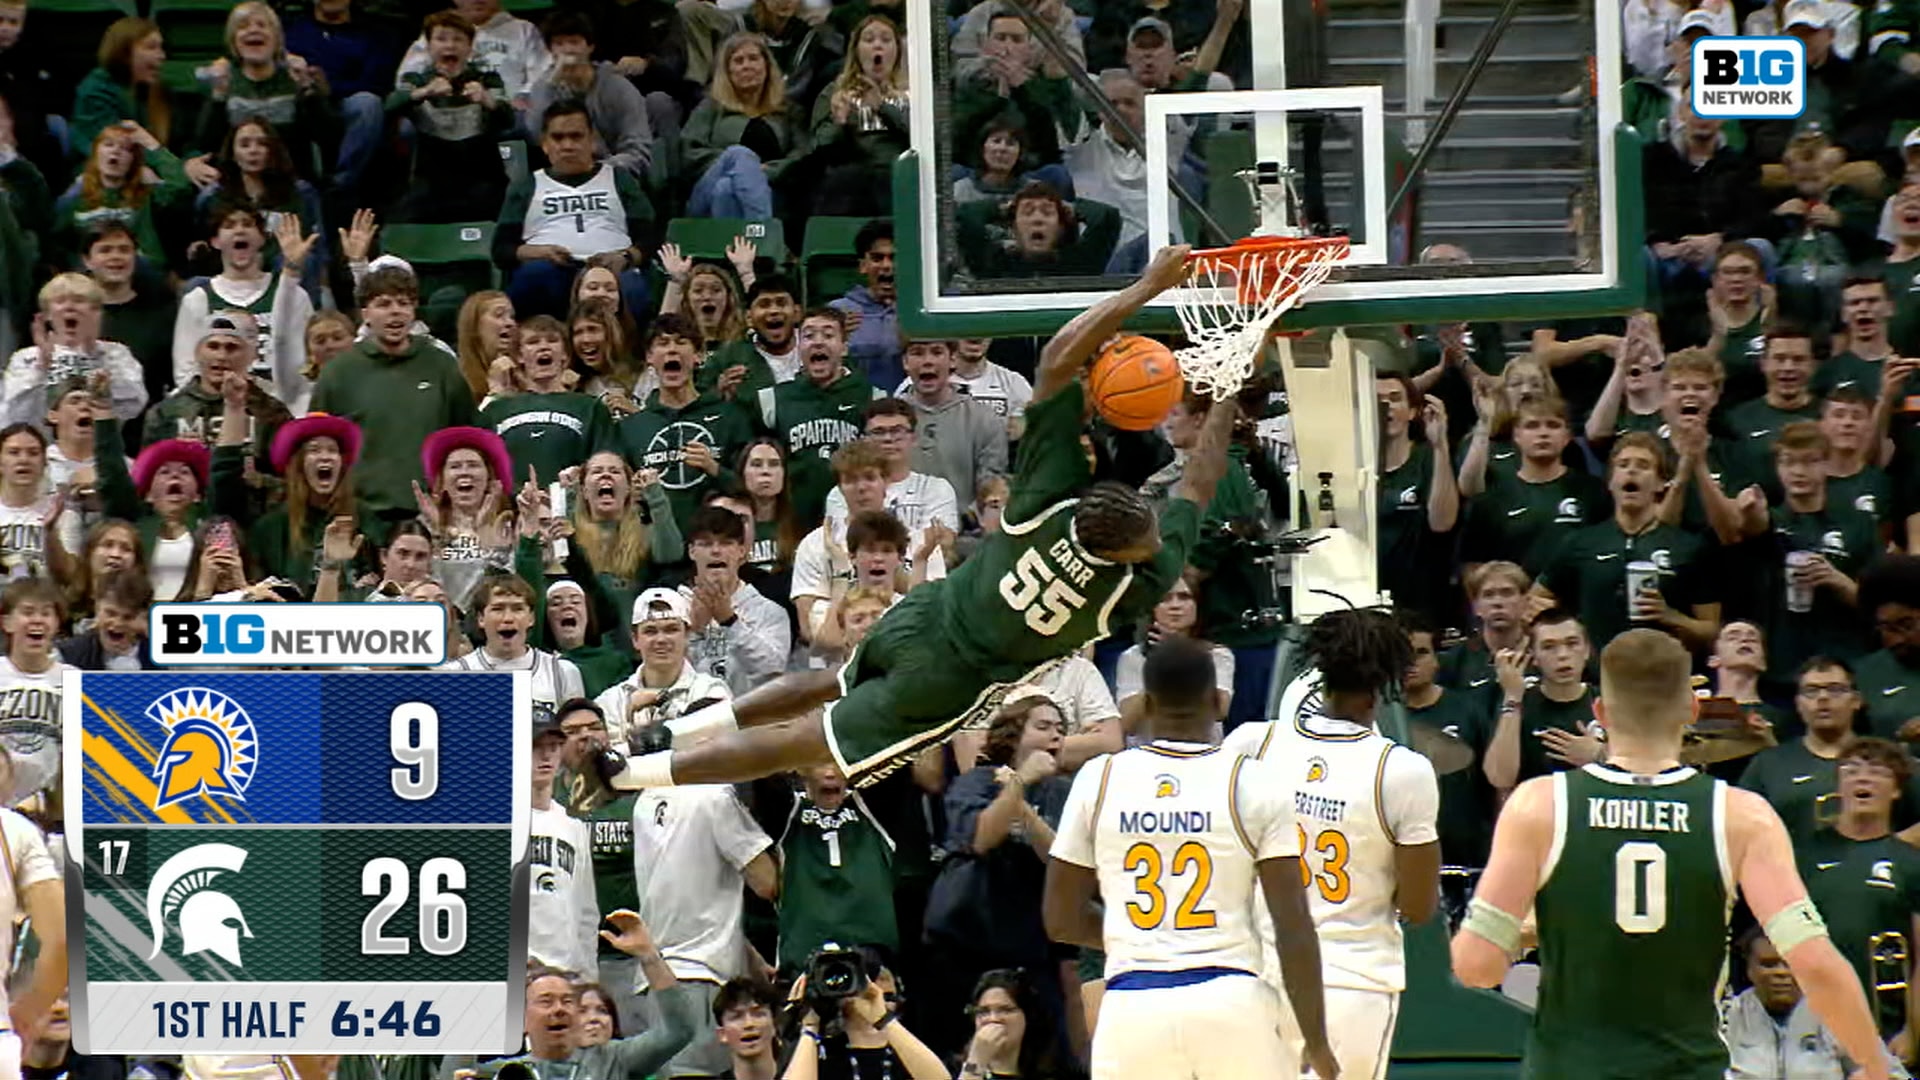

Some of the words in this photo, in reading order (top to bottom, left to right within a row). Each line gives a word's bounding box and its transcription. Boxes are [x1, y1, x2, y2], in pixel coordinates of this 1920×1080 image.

[543, 192, 609, 214] STATE
[576, 213, 585, 232] 1
[177, 416, 255, 443] MS
[789, 419, 860, 452] SPARTANS
[1049, 538, 1095, 588] CARR
[999, 546, 1087, 636] 55
[1120, 811, 1212, 833] MOUNDI
[1588, 797, 1690, 832] KOHLER
[822, 831, 841, 866] 1
[1124, 841, 1217, 930] 32
[1616, 842, 1666, 933] 0
